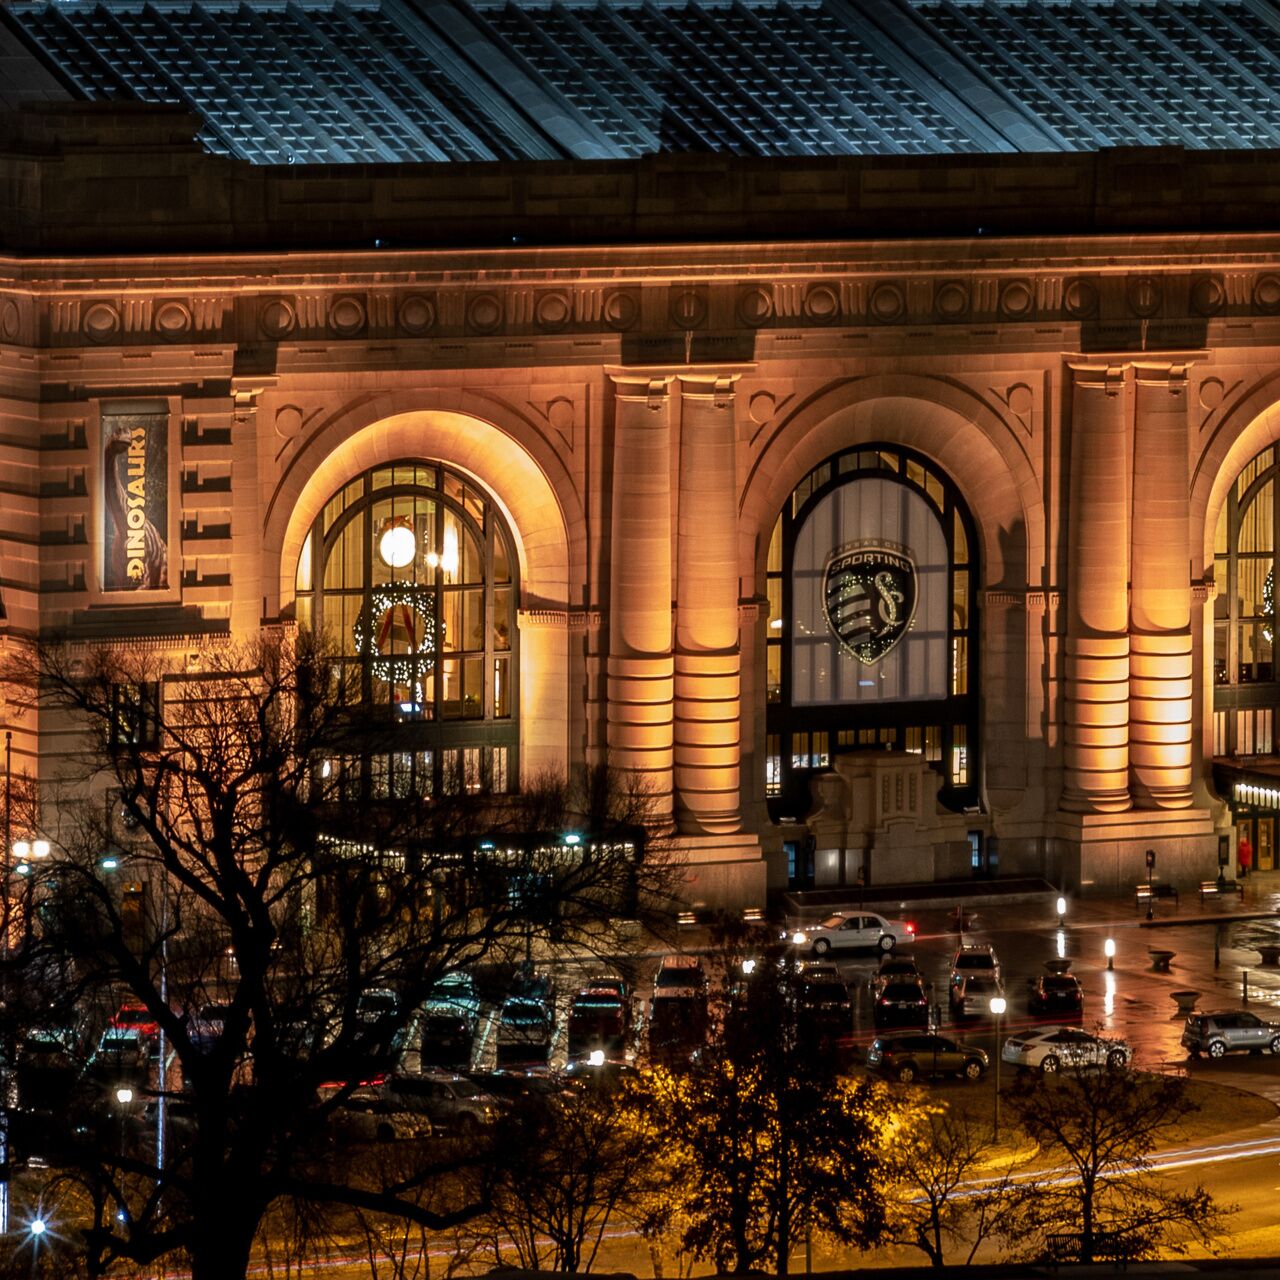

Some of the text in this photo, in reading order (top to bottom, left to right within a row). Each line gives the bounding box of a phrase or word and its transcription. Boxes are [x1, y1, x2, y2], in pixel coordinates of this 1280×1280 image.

[126, 426, 147, 580] DINOSAURS
[829, 540, 880, 558] KANSAS
[830, 552, 912, 575] SPORTING
